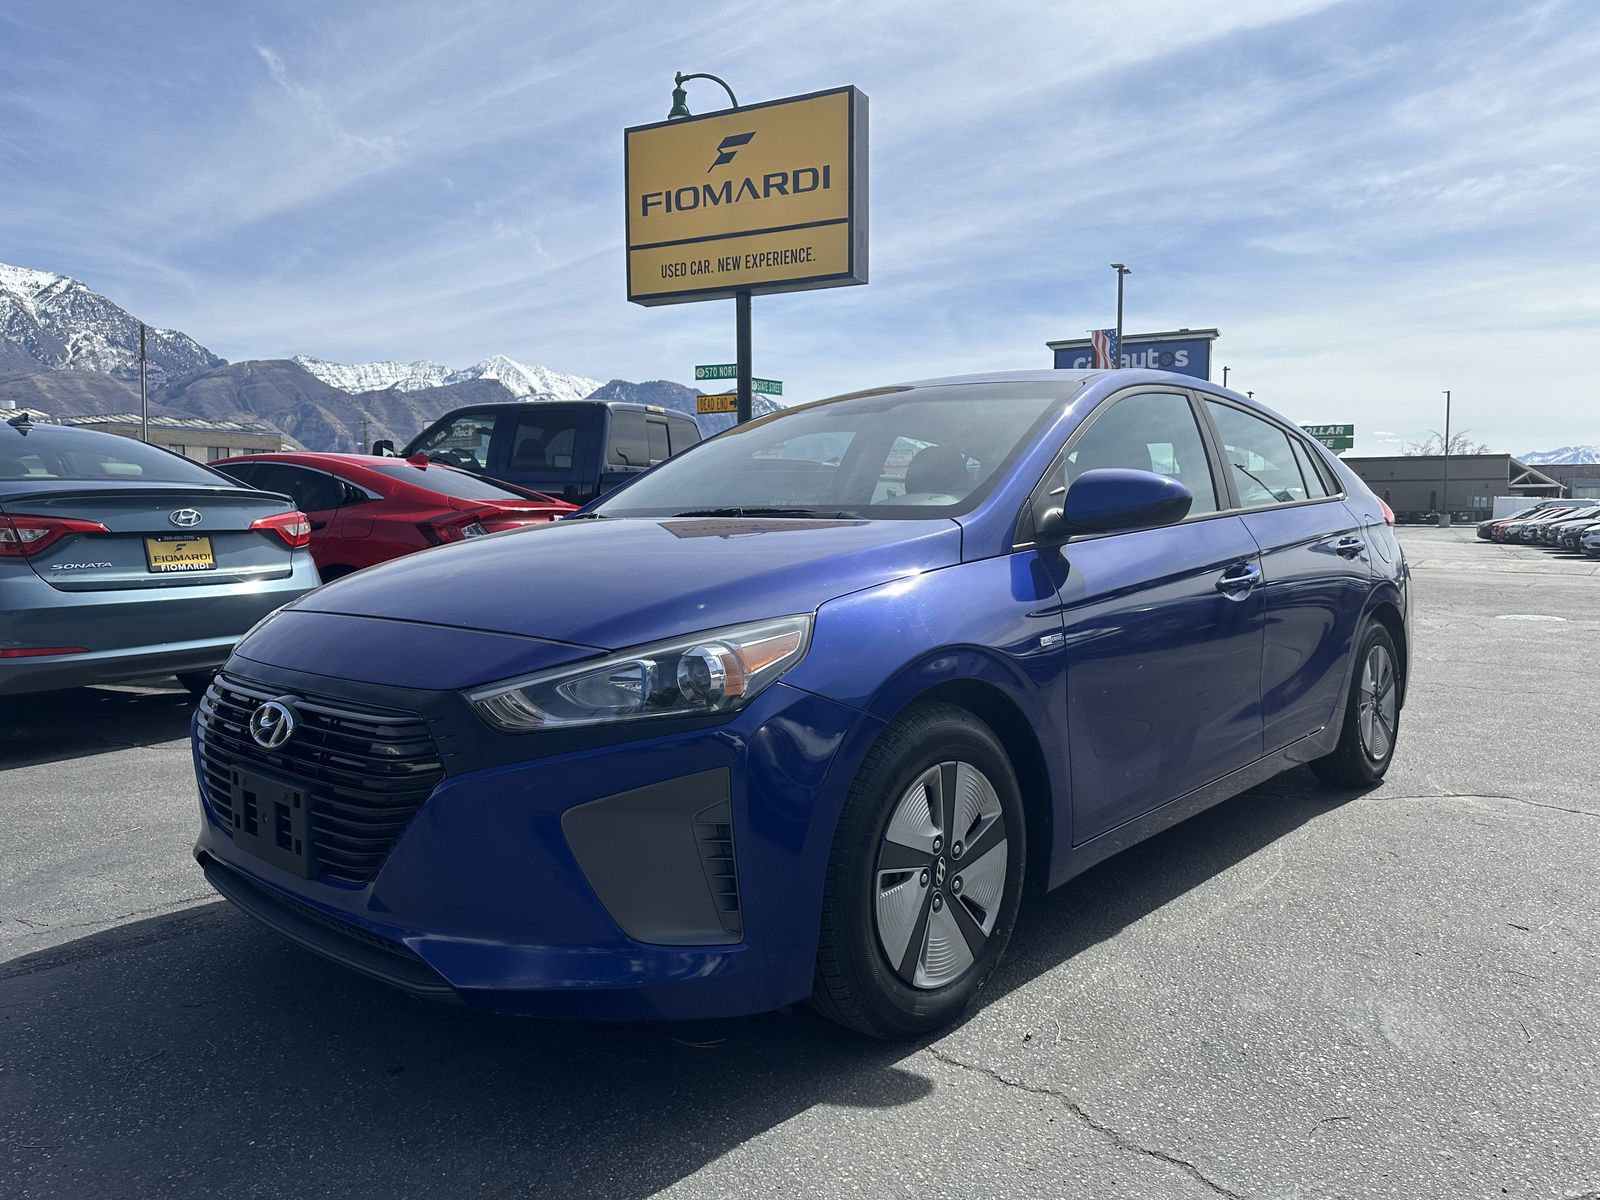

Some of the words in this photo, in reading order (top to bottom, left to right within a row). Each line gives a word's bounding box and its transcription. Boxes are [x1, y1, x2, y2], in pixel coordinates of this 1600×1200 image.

[641, 164, 831, 217] FIOMARDI
[661, 263, 687, 279] USED
[690, 259, 714, 276] CAR.
[717, 255, 741, 273] NEW
[745, 246, 816, 269] EXPERIENCE.
[705, 367, 718, 378] 570
[719, 366, 737, 377] NORT
[757, 380, 769, 392] STATE
[769, 382, 782, 393] STREET
[700, 398, 715, 411] DEAD
[717, 397, 728, 410] END
[1304, 426, 1345, 436] OLLAR
[153, 553, 211, 562] FIOMARDI
[50, 562, 112, 570] SONATA
[160, 563, 209, 571] FIOMARDI
